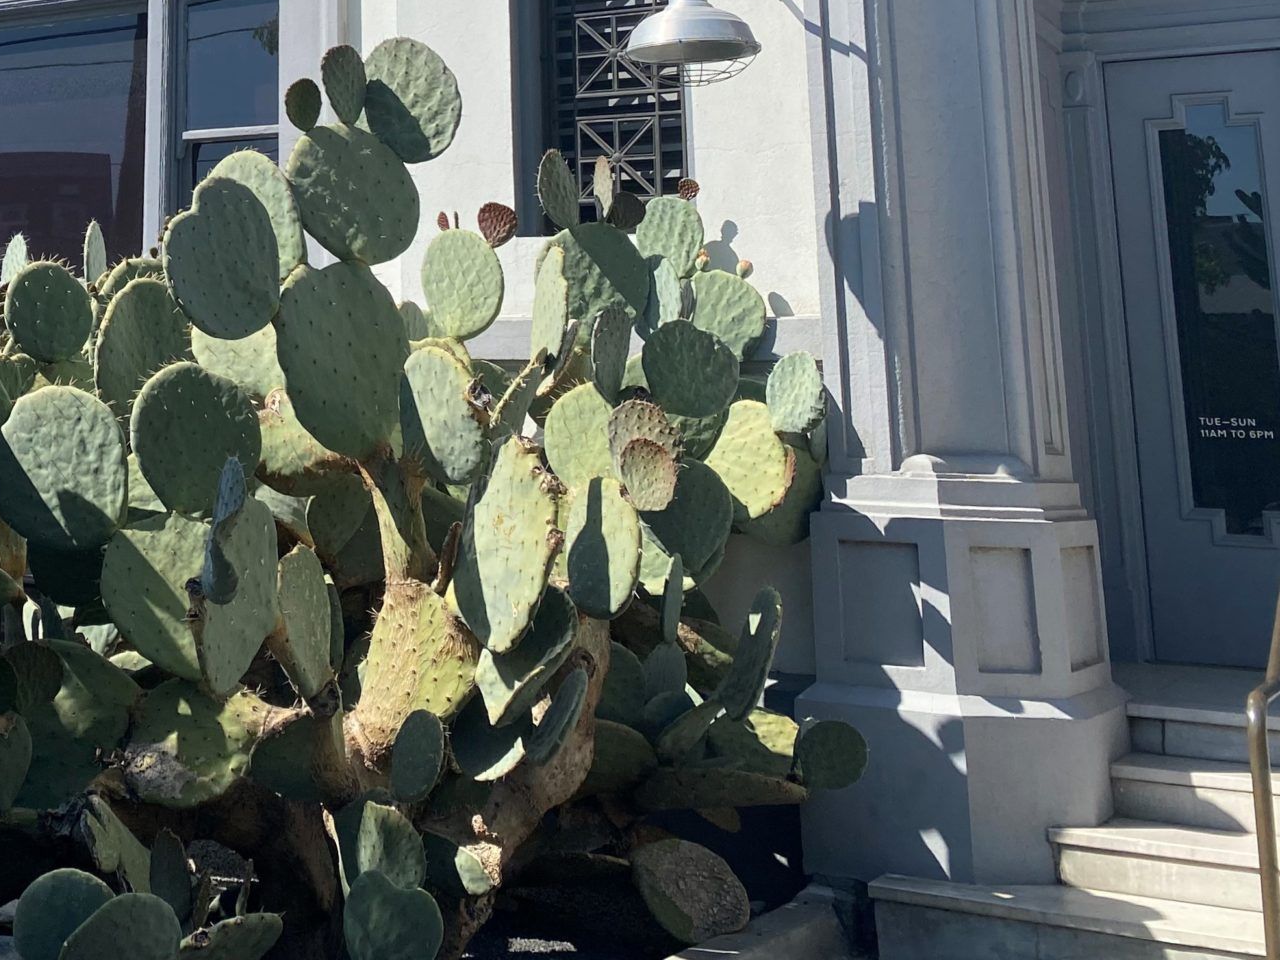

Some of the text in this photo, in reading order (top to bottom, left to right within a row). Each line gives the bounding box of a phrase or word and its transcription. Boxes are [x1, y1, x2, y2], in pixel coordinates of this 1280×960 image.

[1200, 429, 1274, 439] 11AM TO 6PM
